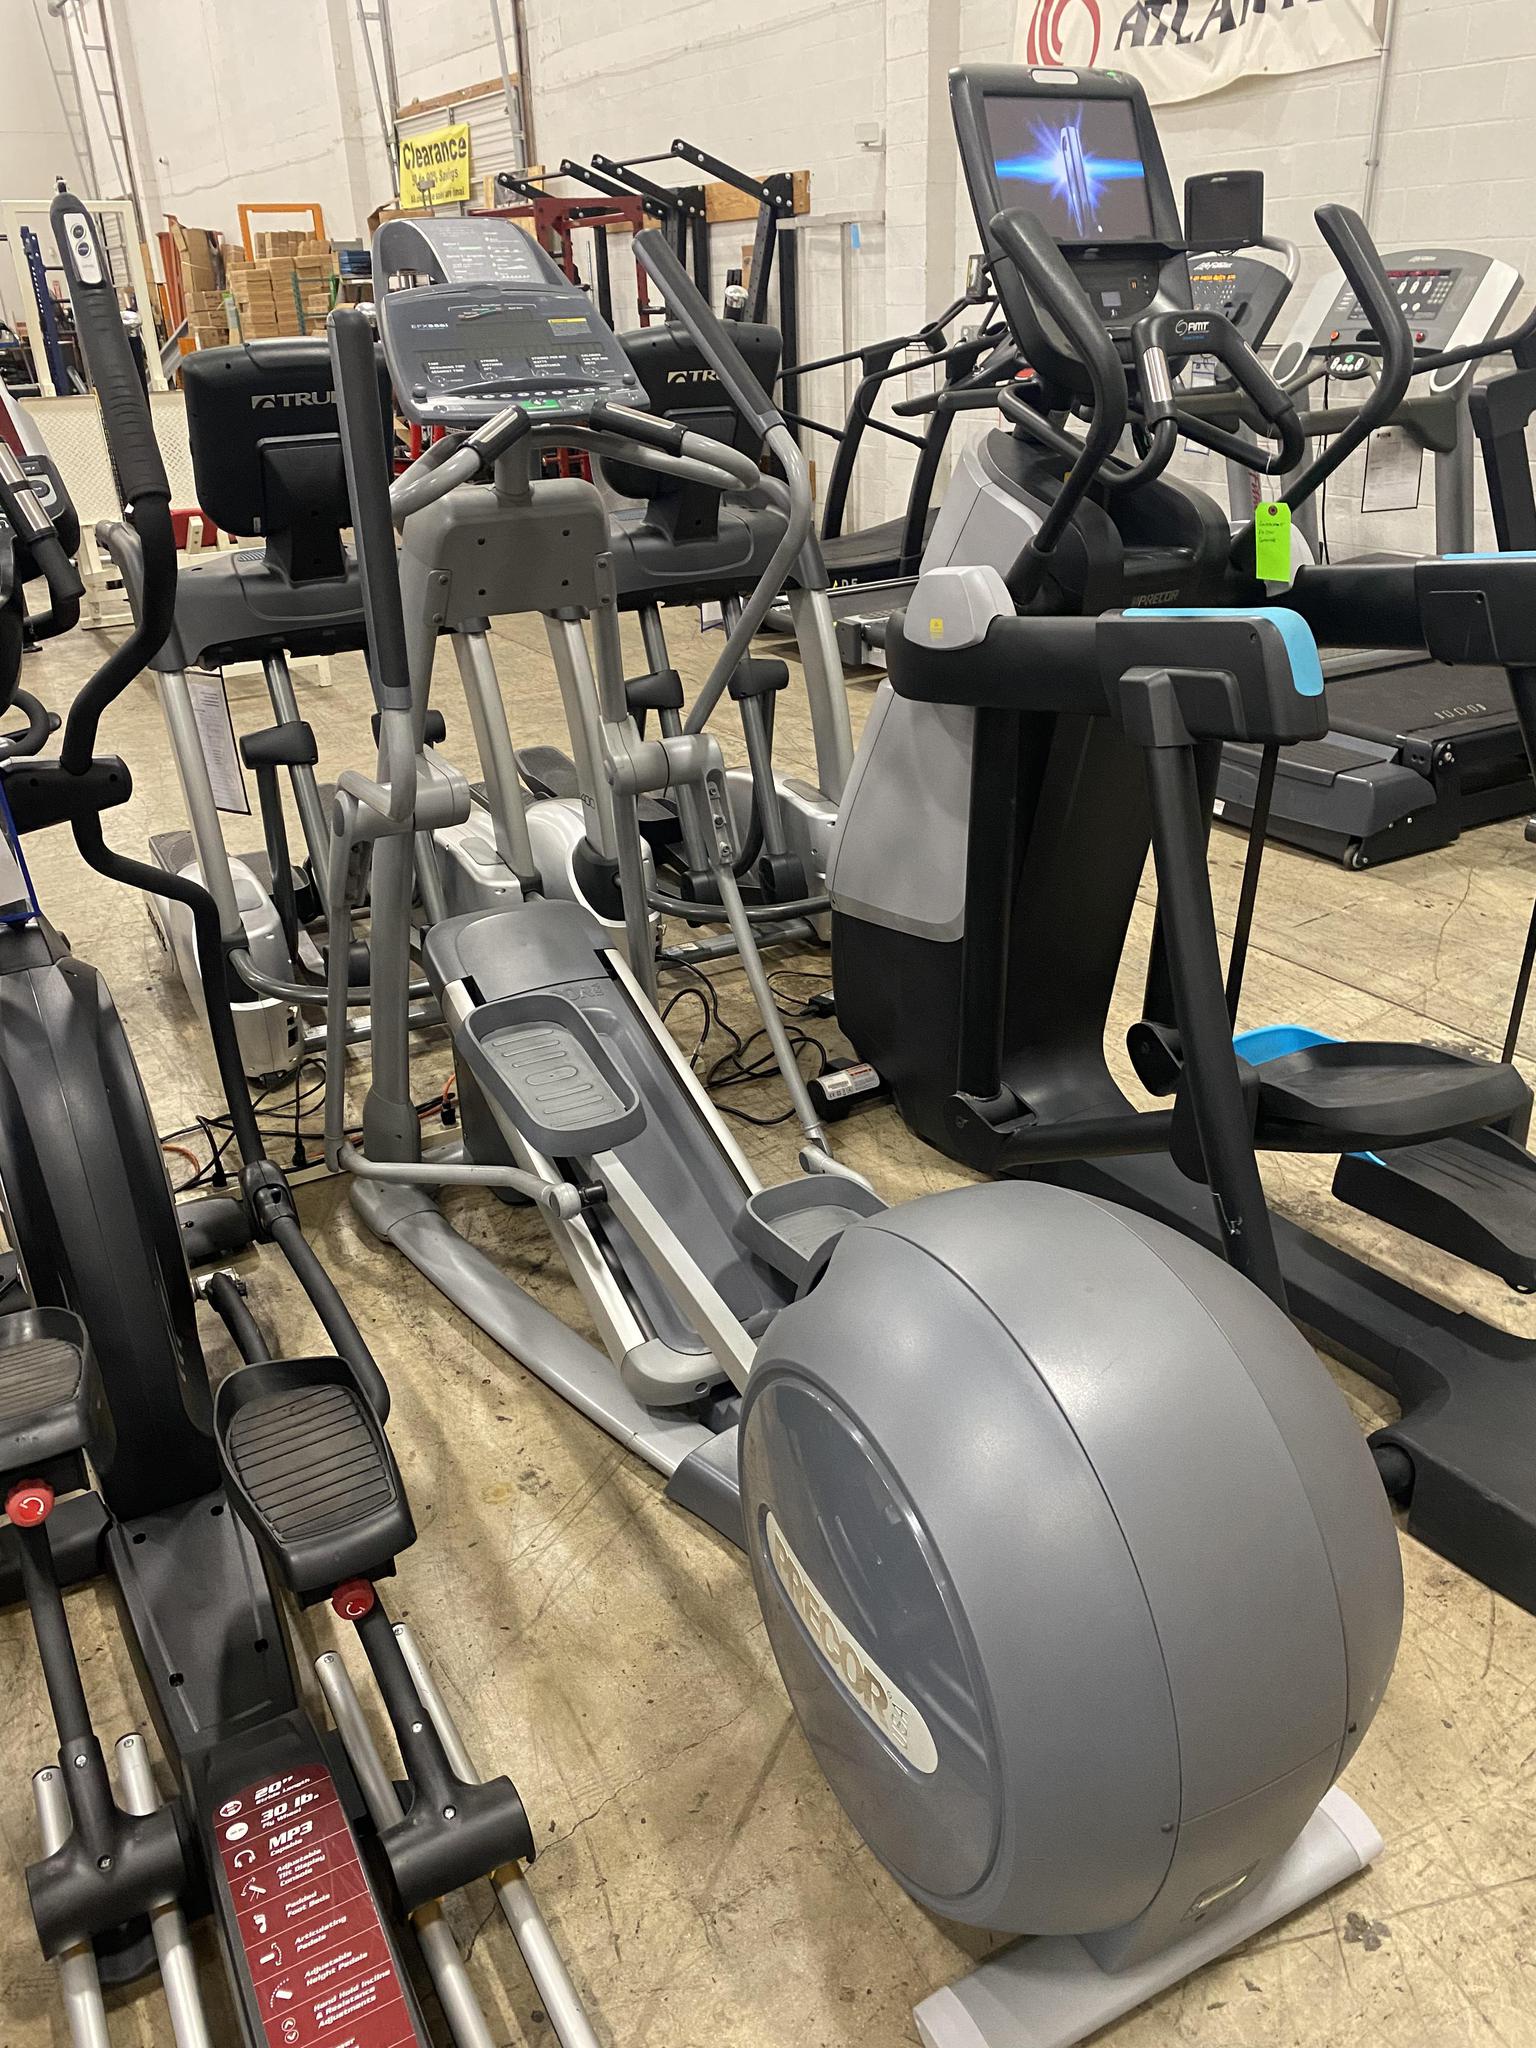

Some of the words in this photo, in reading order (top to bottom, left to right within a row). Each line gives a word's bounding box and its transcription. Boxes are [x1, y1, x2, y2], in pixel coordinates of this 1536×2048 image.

[1114, 0, 1325, 50] ATLA
[403, 136, 467, 170] Clearance
[688, 369, 721, 383] TR
[774, 1530, 892, 1732] PRECOR
[255, 1790, 281, 1806] Stride
[282, 1777, 311, 1794] Length
[260, 1802, 288, 1824] 30
[294, 1792, 320, 1809] lb.
[262, 1818, 275, 1829] Fly
[276, 1807, 302, 1822] Wheel
[268, 1820, 313, 1851] MP3
[270, 1838, 303, 1857] Capable
[276, 1848, 322, 1874] Adjustable
[278, 1868, 293, 1881] Tilt
[294, 1854, 326, 1874] Display
[279, 1866, 314, 1887] Console
[284, 1890, 318, 1911] Padded
[287, 1905, 308, 1918] Foot
[308, 1892, 331, 1908] Beds
[294, 1915, 348, 1946] Articulating
[296, 1933, 327, 1953] Pedals
[304, 1950, 353, 1979] Adjustable
[306, 1967, 337, 1987] Height
[338, 1951, 369, 1971] Pedals
[313, 1994, 338, 2013] Hand
[338, 1984, 360, 2000] Hold
[361, 1968, 391, 1988] Incline
[315, 2011, 325, 2021] &
[325, 1986, 376, 2016] Resistance
[318, 1993, 377, 2030] Adjustments
